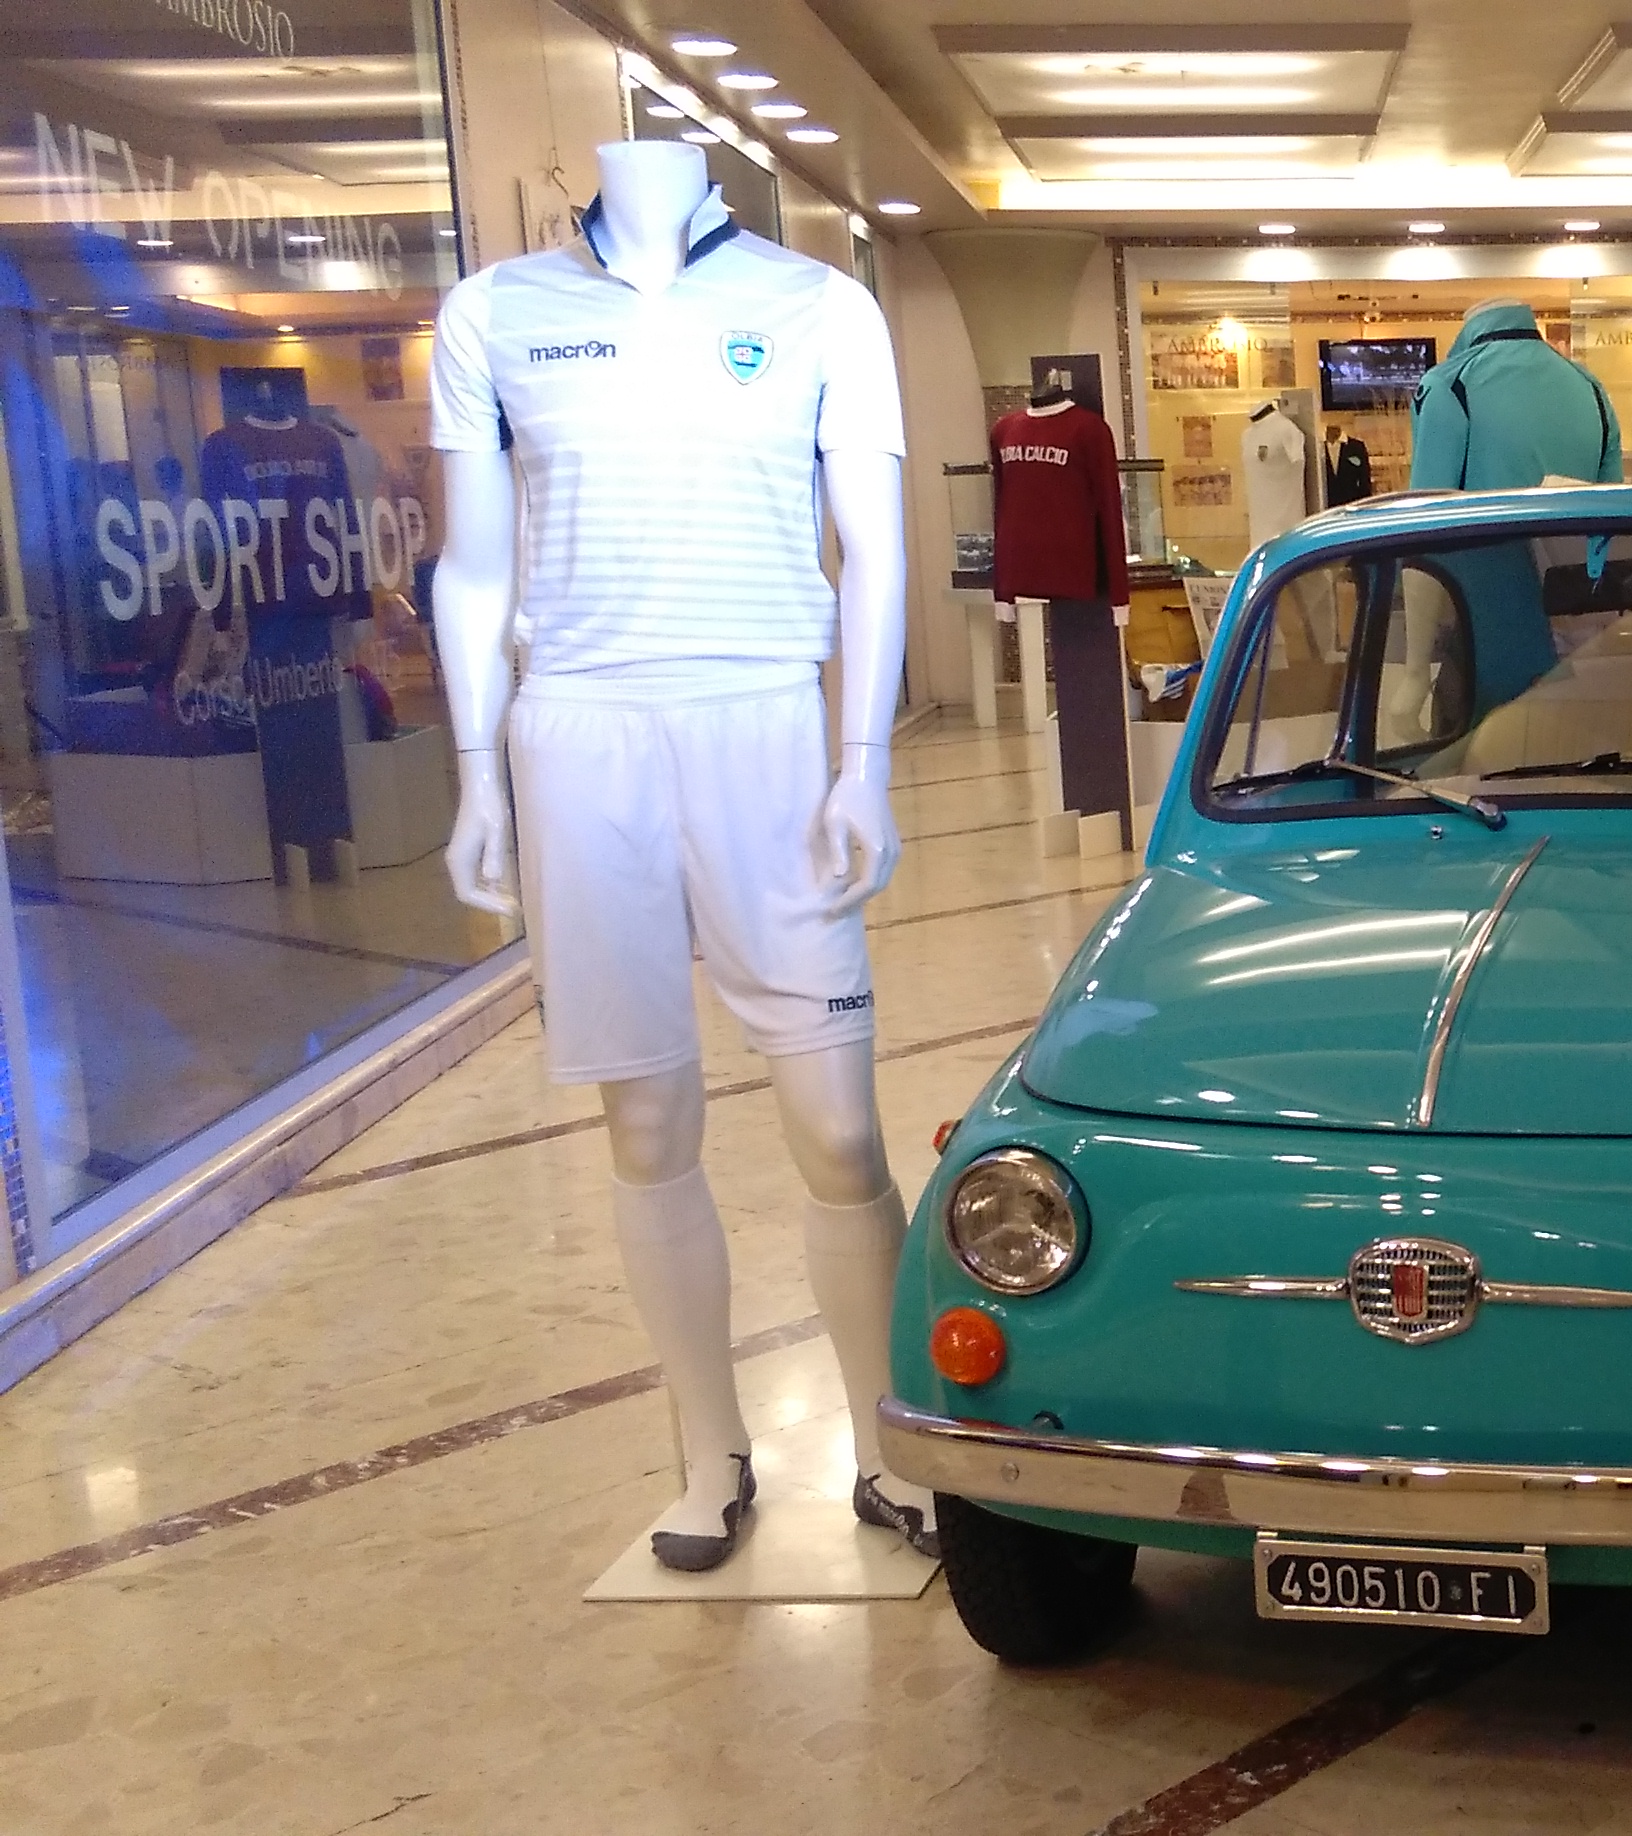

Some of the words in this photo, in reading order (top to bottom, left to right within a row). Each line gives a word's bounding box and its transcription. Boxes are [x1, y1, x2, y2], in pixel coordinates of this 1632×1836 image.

[34, 112, 174, 253] NEW
[202, 169, 403, 301] OPENING
[529, 340, 616, 362] macron
[1024, 445, 1069, 466] CALCIO
[97, 497, 290, 622] SPORT
[304, 496, 426, 598] SHOP
[1281, 1561, 1440, 1612] 490510
